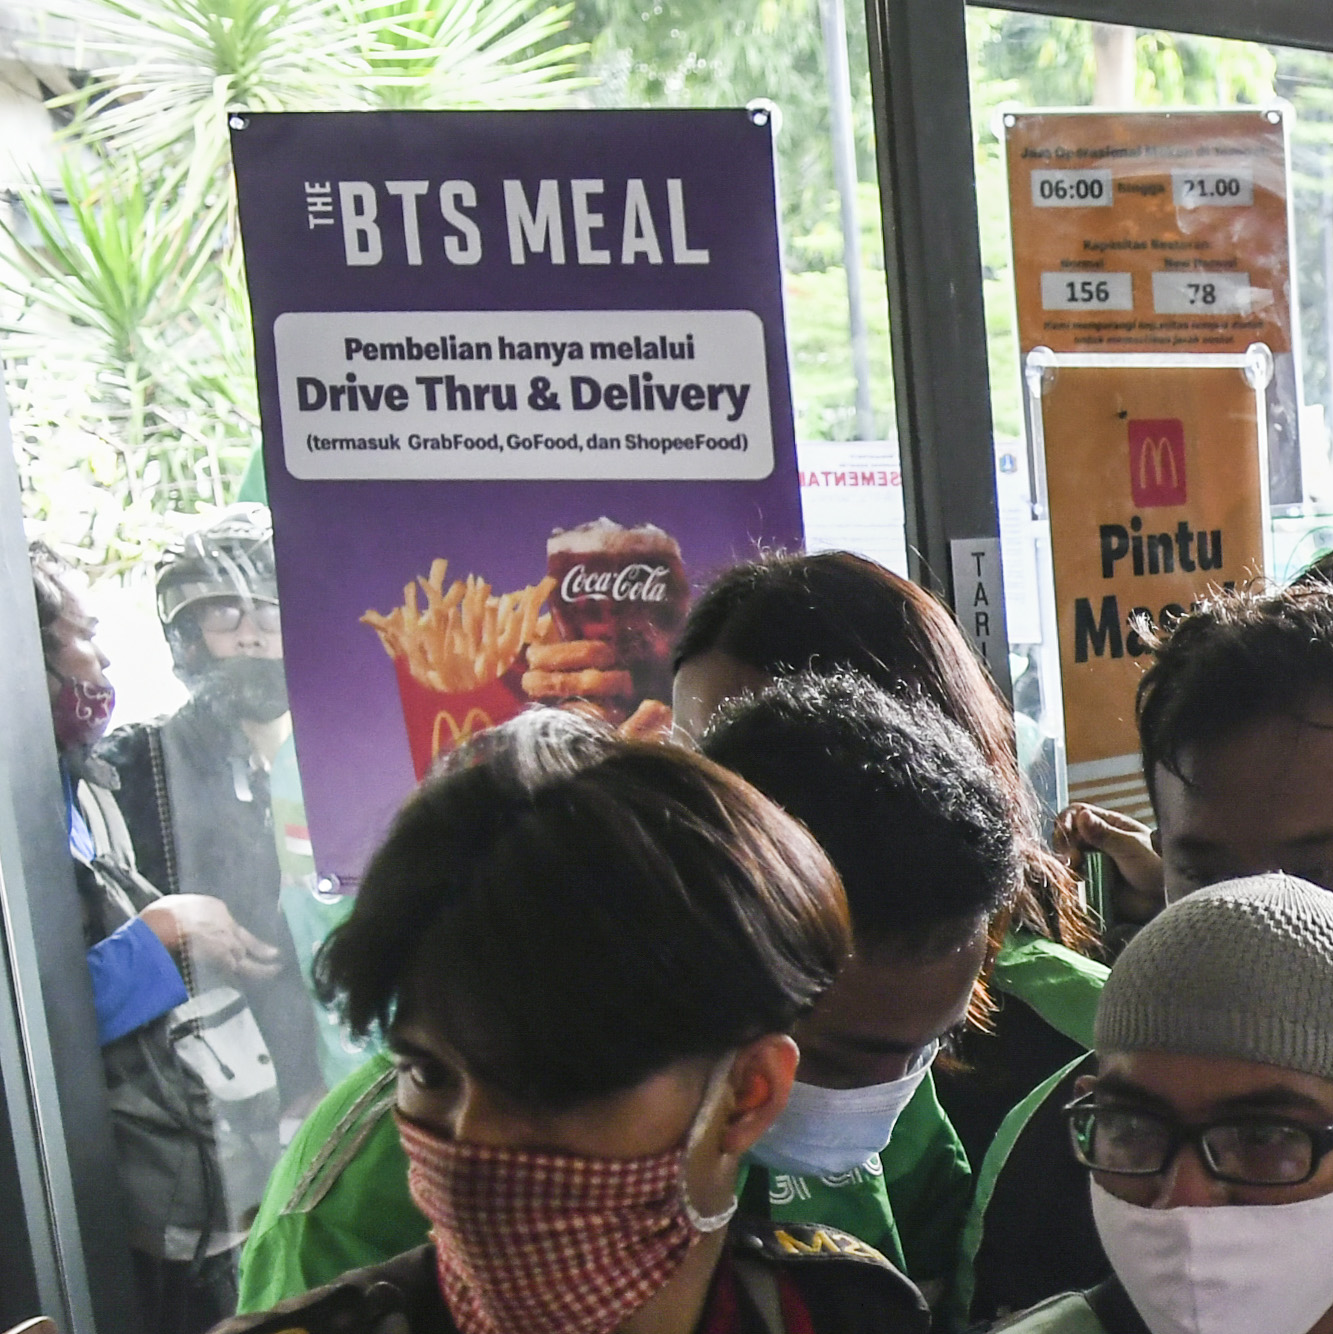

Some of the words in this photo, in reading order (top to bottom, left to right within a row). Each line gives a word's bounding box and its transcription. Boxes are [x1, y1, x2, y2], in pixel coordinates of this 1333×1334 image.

[304, 180, 335, 229] THE
[1040, 178, 1104, 200] 06:00
[338, 179, 483, 266] BTS
[503, 178, 710, 266] MEAL
[1065, 281, 1110, 303] 156
[344, 335, 493, 362] Pembelian
[497, 335, 584, 367] hanya
[590, 333, 695, 361] melalui
[296, 372, 409, 413] Drive
[416, 375, 517, 412] Thru
[527, 375, 560, 412] &
[570, 371, 751, 421] Delivery
[306, 433, 401, 454] (termasuk
[407, 433, 504, 455] GrabFood,
[506, 433, 584, 454] GoFood,
[586, 433, 621, 452] dan
[625, 432, 749, 456] ShopeeFood)
[1099, 515, 1224, 579] Pintu
